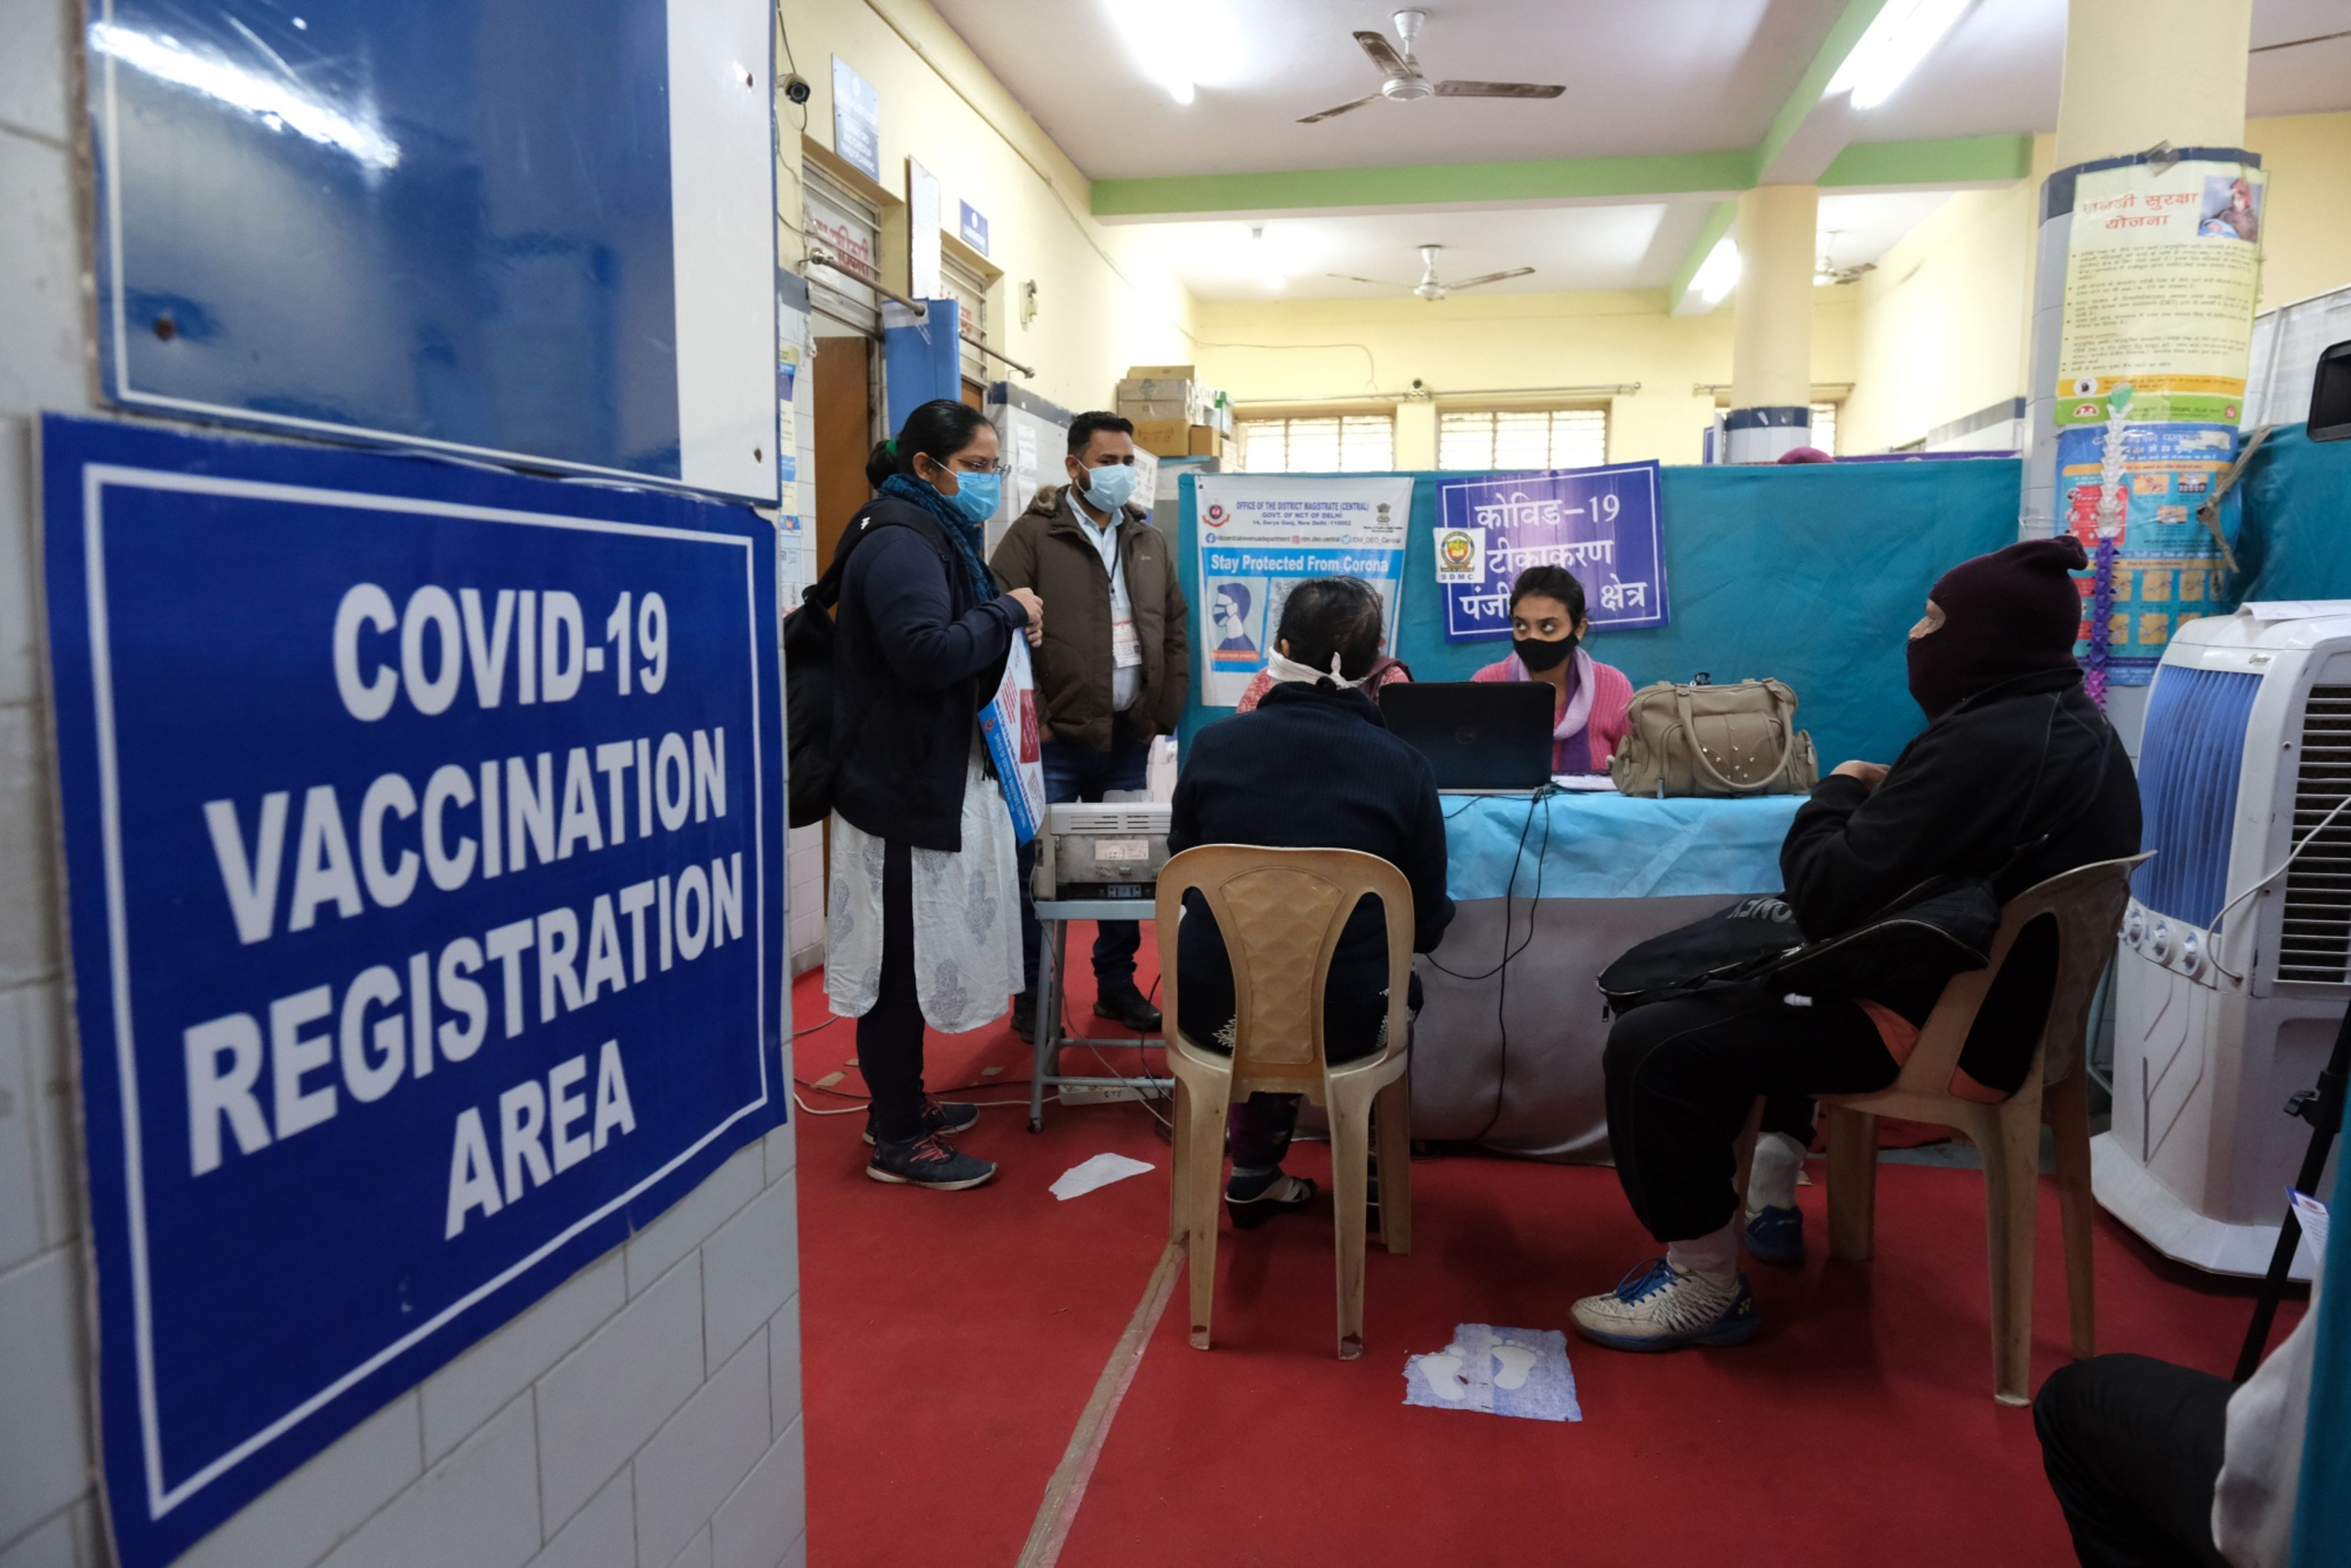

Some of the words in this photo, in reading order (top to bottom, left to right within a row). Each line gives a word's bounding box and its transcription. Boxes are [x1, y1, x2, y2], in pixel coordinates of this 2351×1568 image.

[2145, 193, 2199, 210] सुरक्षा
[2105, 215, 2170, 229] योजना
[1236, 502, 1255, 510] OFFICE
[1257, 502, 1263, 510] OF
[1265, 502, 1276, 510] THE
[1278, 502, 1302, 510] DISTRICT
[1304, 502, 1339, 511] MAGISTRATE
[1340, 502, 1370, 511] (CENTRAL)
[1211, 554, 1239, 574] Stay
[1242, 554, 1304, 571] Protected
[1307, 556, 1339, 571] From
[1343, 556, 1389, 572] Corona
[1487, 537, 1615, 574] टीकाकरण
[1601, 573, 1648, 611] क्षेत्र
[332, 581, 669, 723] COVID-19
[204, 726, 727, 947] VACCINATION
[182, 851, 744, 1179] REGISTRATION
[444, 1038, 637, 1242] AREA
